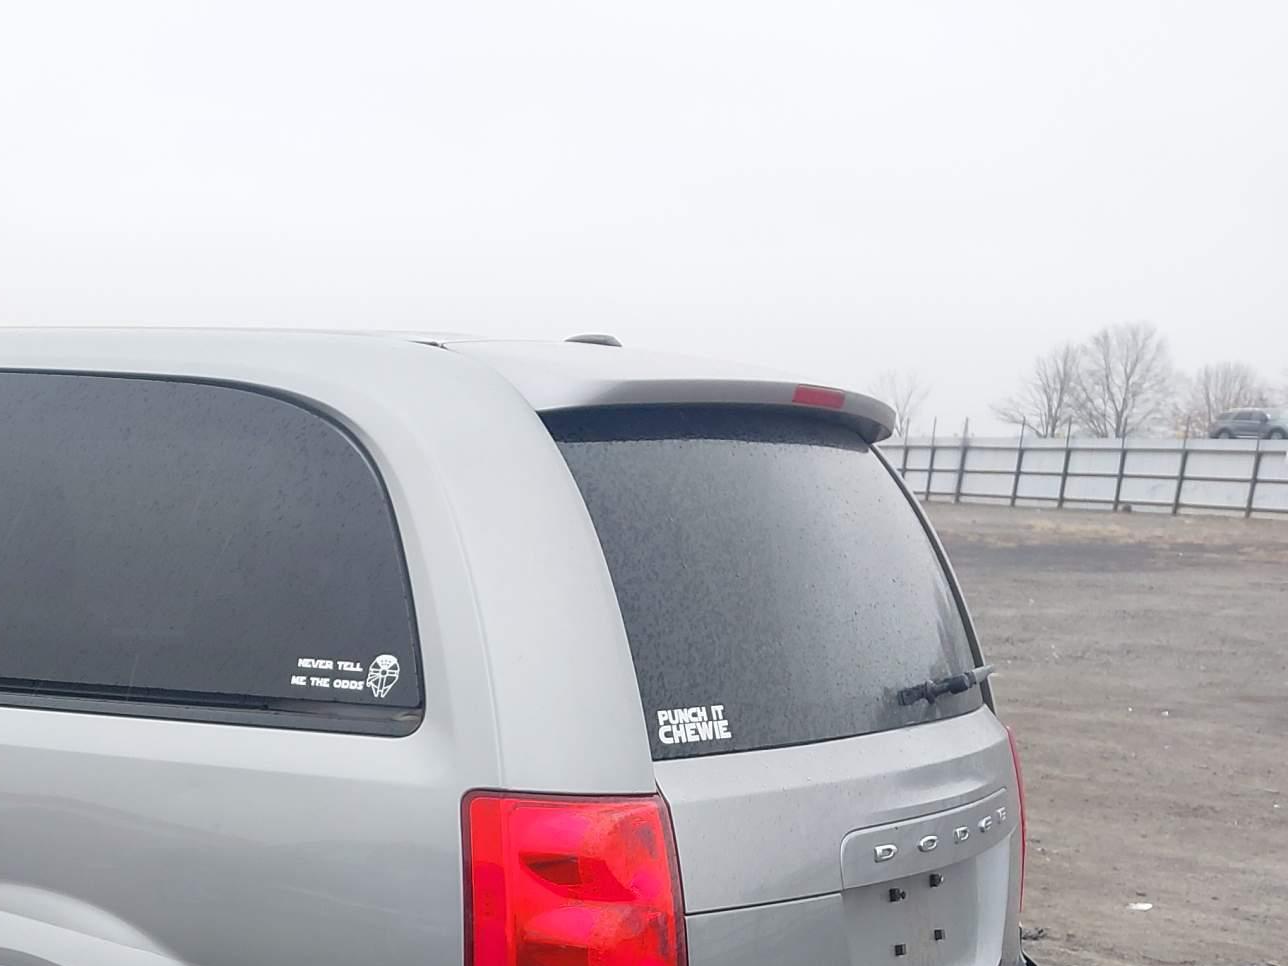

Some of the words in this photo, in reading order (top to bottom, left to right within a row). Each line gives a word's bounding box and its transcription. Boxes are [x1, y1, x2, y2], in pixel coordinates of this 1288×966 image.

[298, 658, 334, 670] NEVER
[337, 661, 364, 672] TELL
[291, 675, 307, 686] ME
[310, 677, 330, 688] THE
[333, 679, 364, 690] ODDS
[657, 706, 708, 726] PUNCH
[711, 705, 724, 721] IT
[658, 720, 732, 745] CHEWIE
[874, 807, 1007, 863] DODGE
